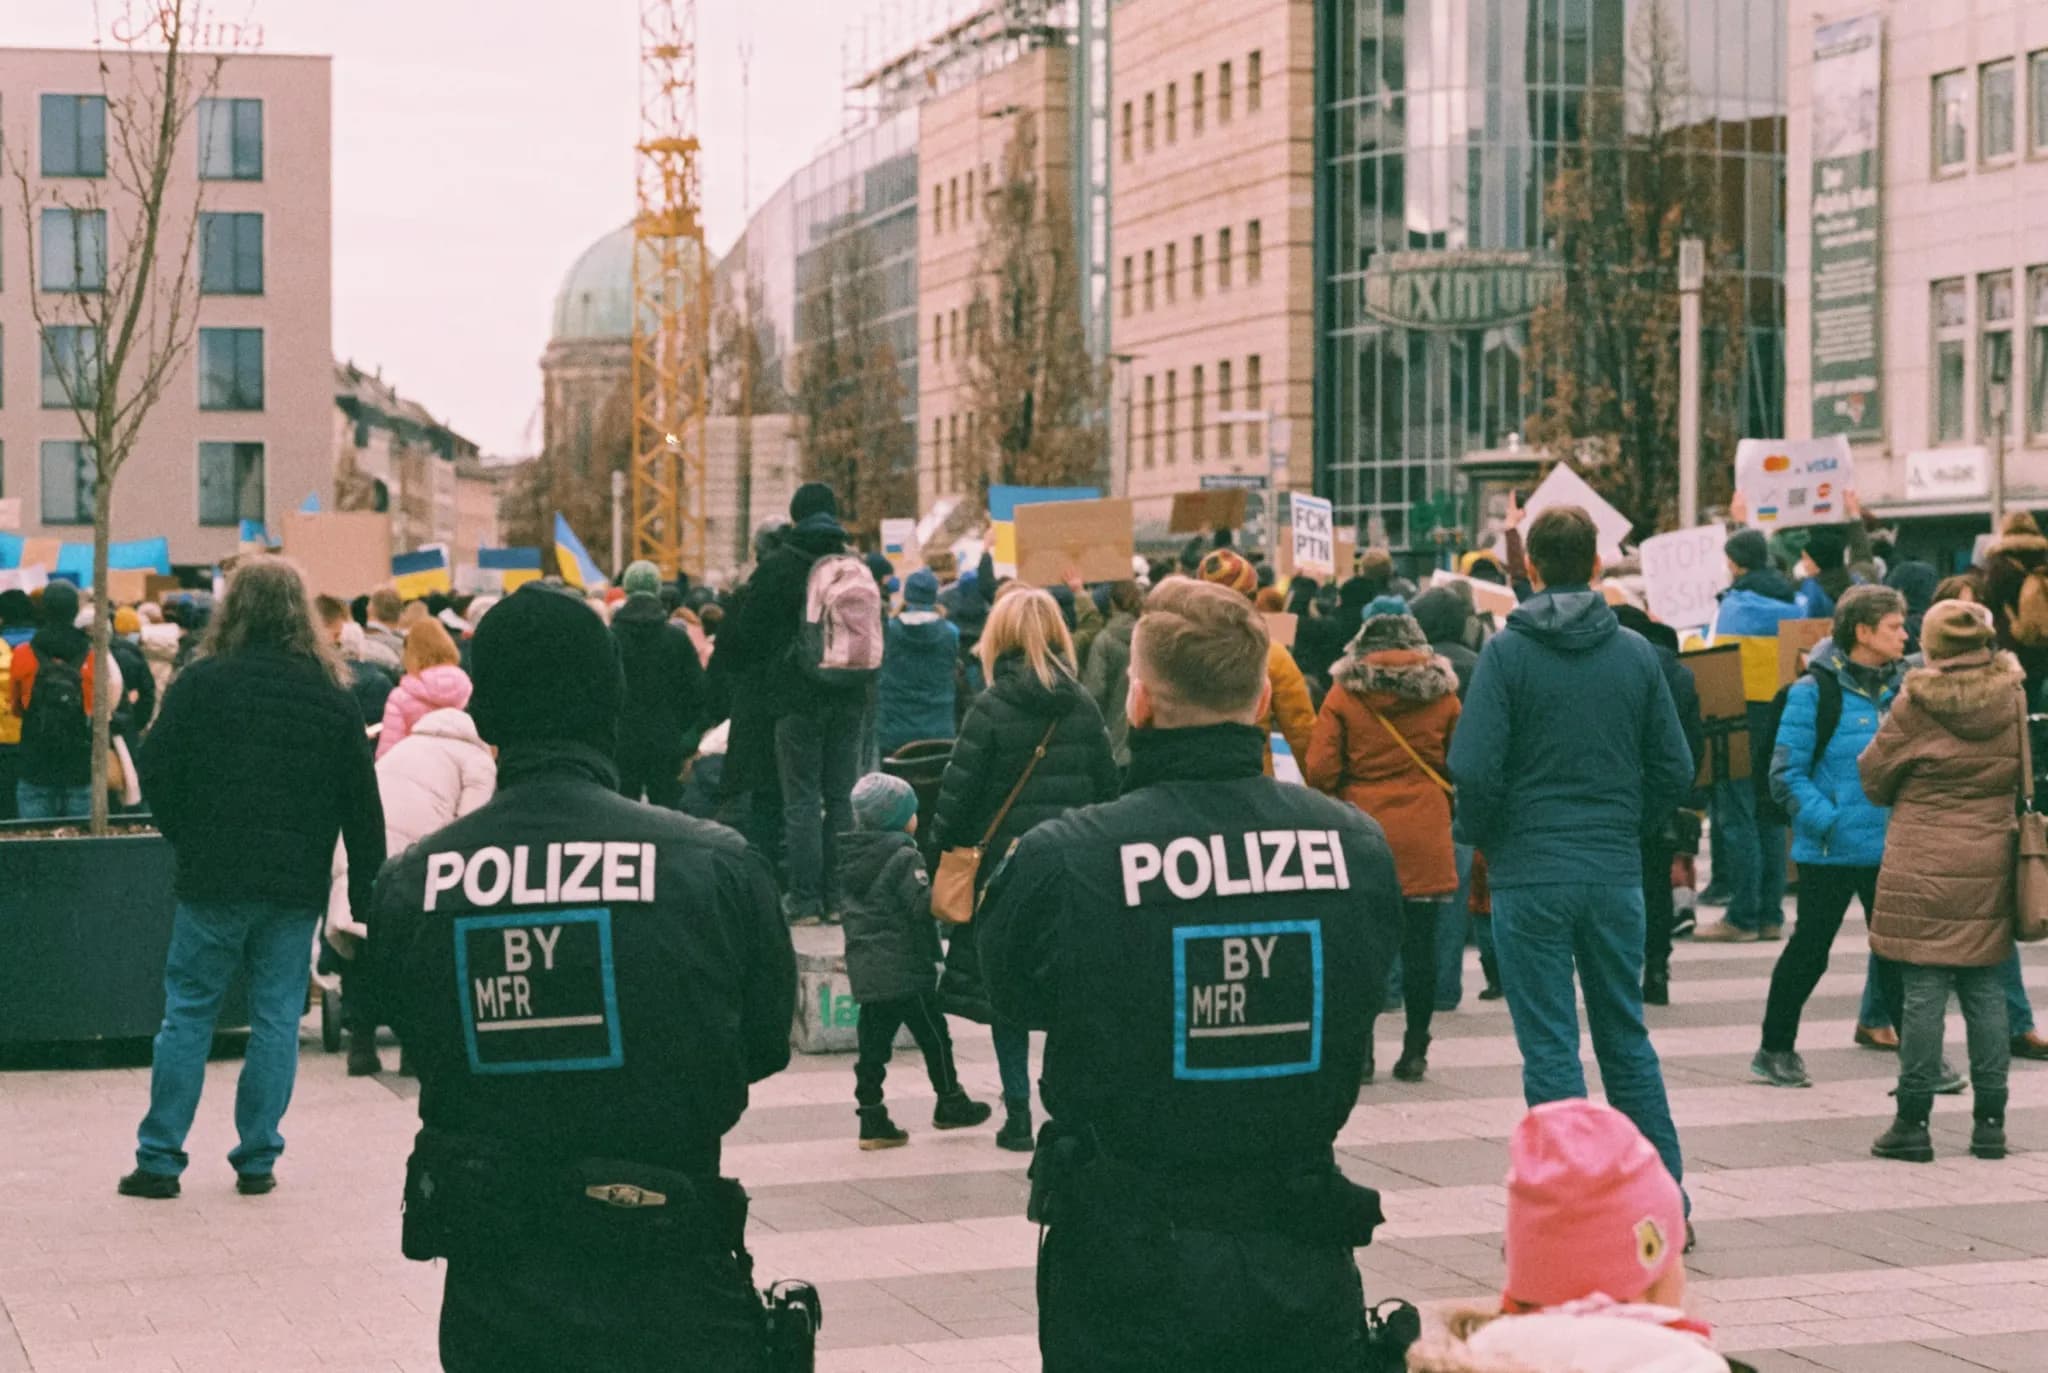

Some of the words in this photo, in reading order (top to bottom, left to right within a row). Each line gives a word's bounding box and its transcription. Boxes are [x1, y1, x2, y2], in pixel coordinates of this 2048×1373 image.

[1295, 506, 1329, 535] FCK
[1296, 534, 1330, 562] PTN
[1649, 535, 1715, 578] STOP
[423, 841, 656, 912] POLIZEI
[1120, 829, 1350, 907] POLIZEI
[503, 926, 562, 973] BY
[1222, 935, 1279, 981] BY
[475, 975, 533, 1019] MFR
[1192, 983, 1247, 1026] MFR
